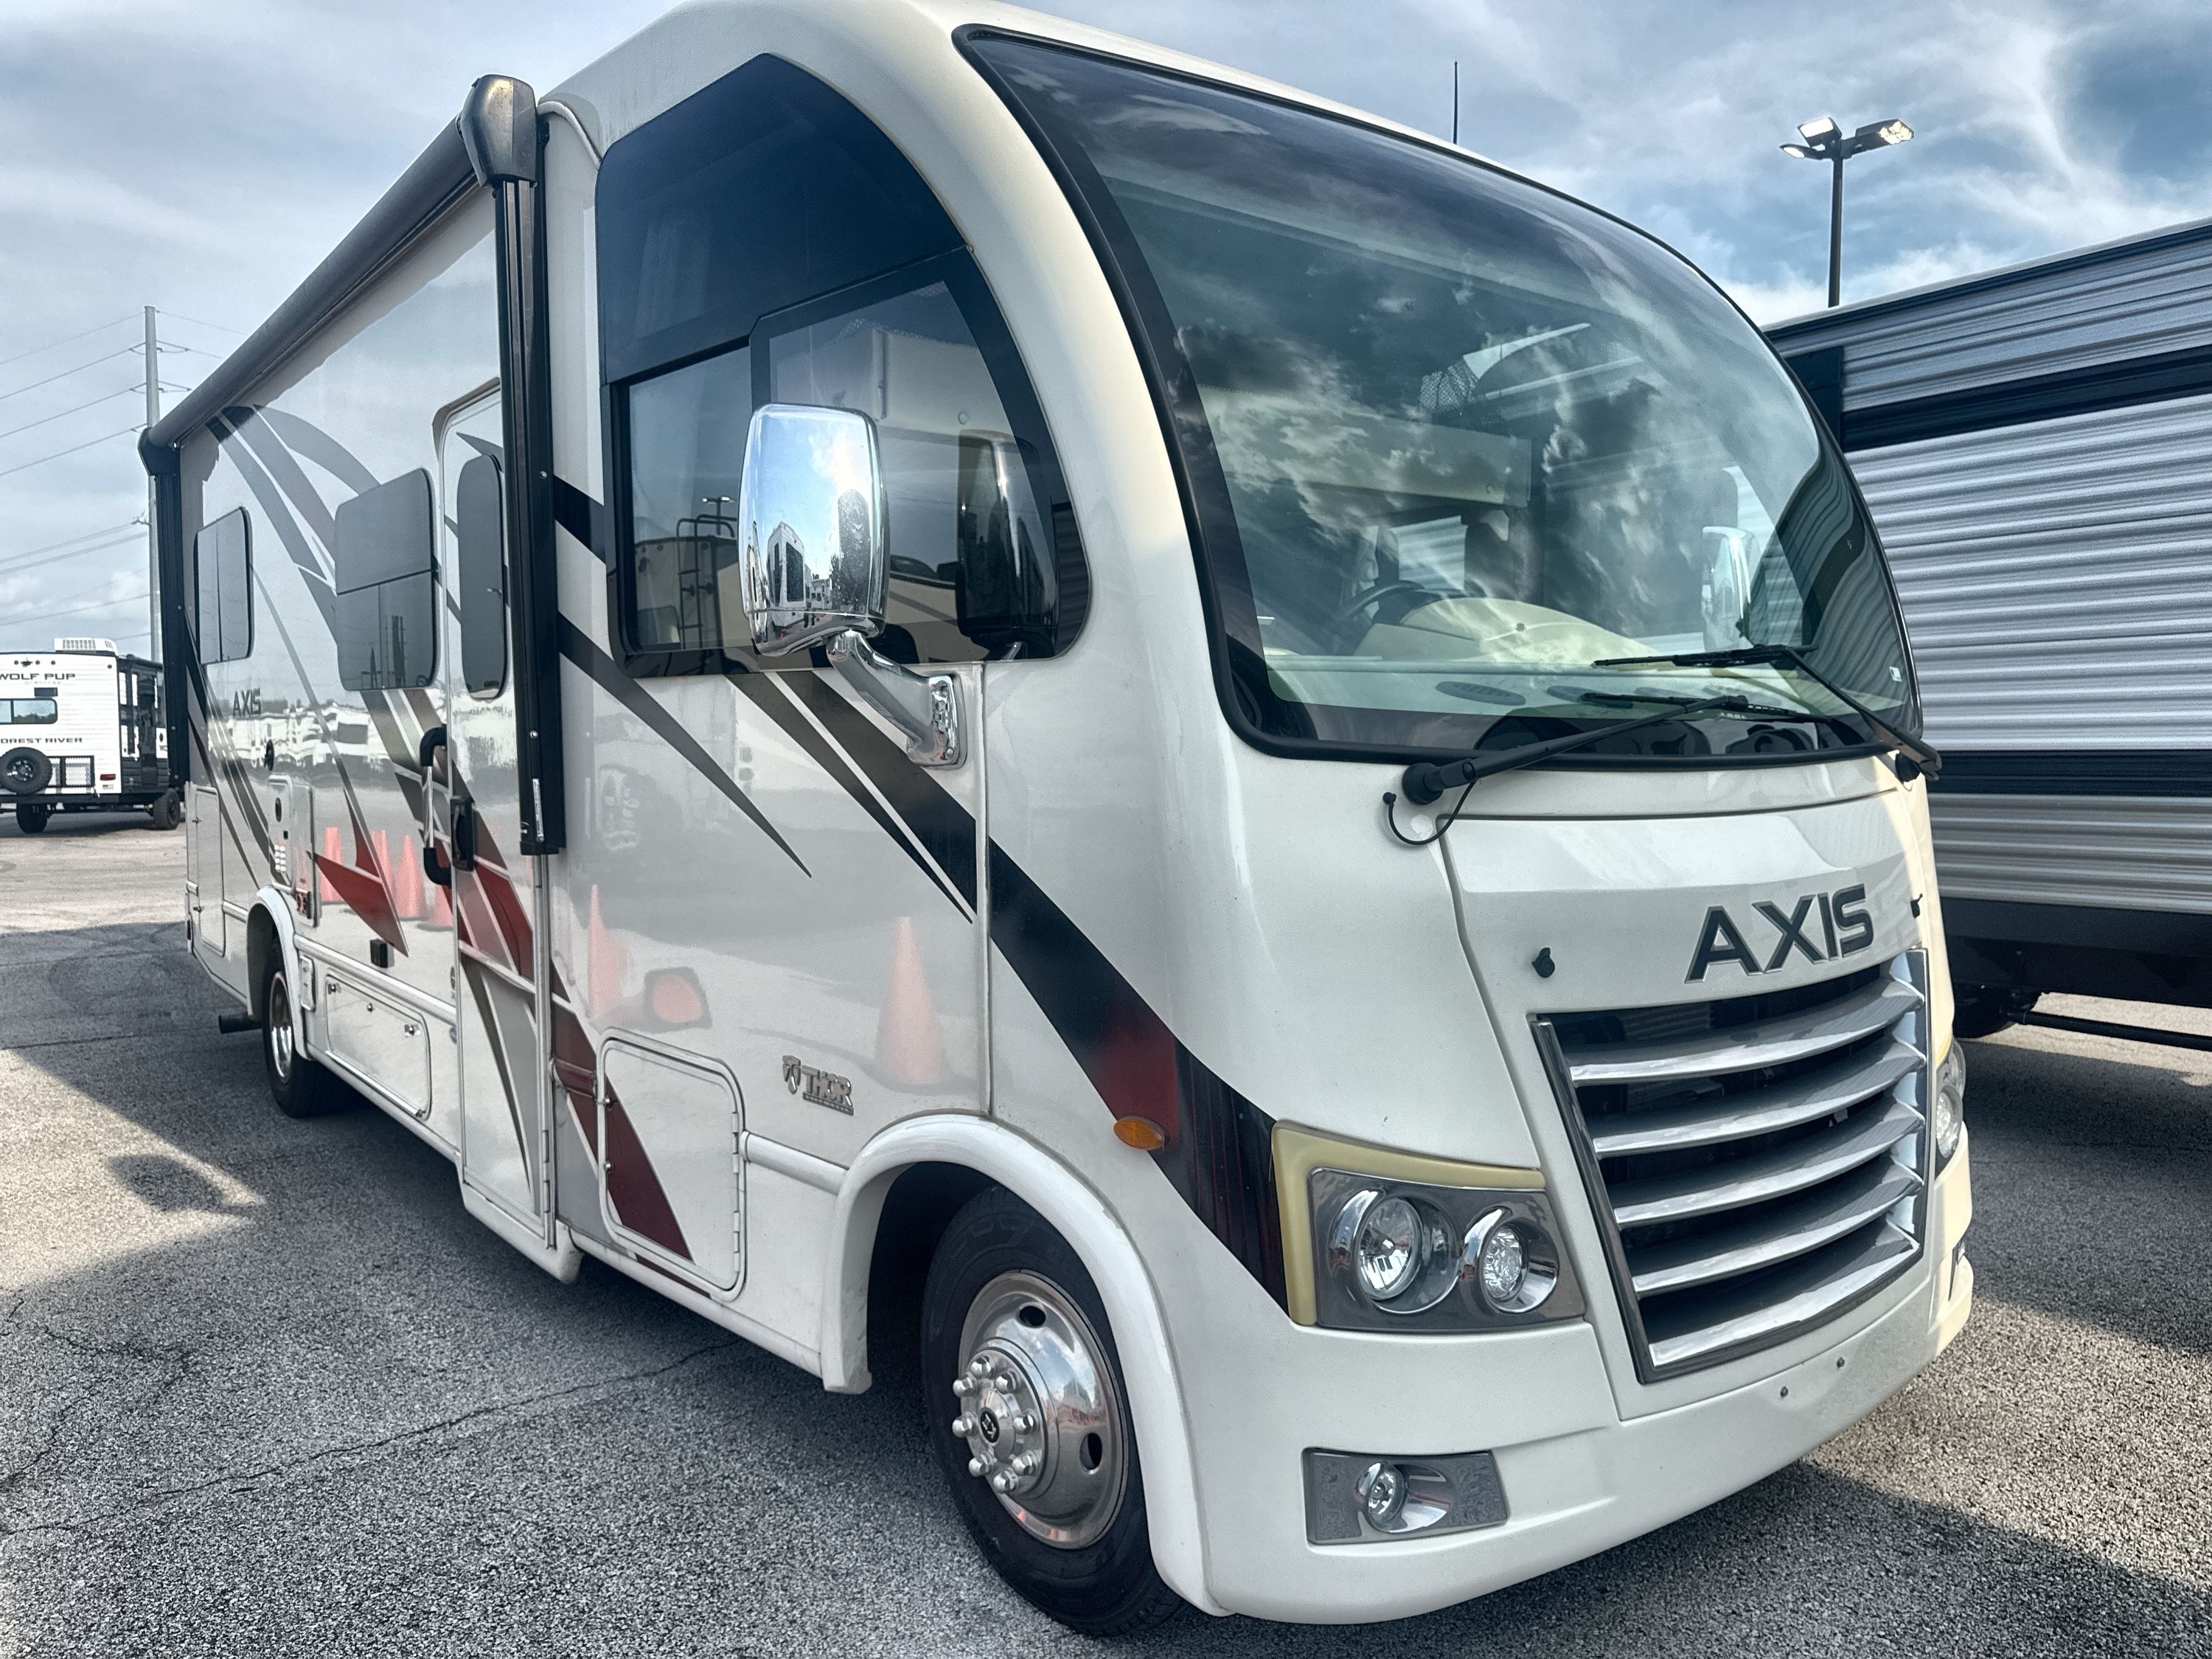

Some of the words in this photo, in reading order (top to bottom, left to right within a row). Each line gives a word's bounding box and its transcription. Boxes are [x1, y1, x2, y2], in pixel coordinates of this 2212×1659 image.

[233, 688, 261, 719] AXIS
[1684, 883, 1874, 984] AXIS
[801, 1065, 852, 1107] THOR
